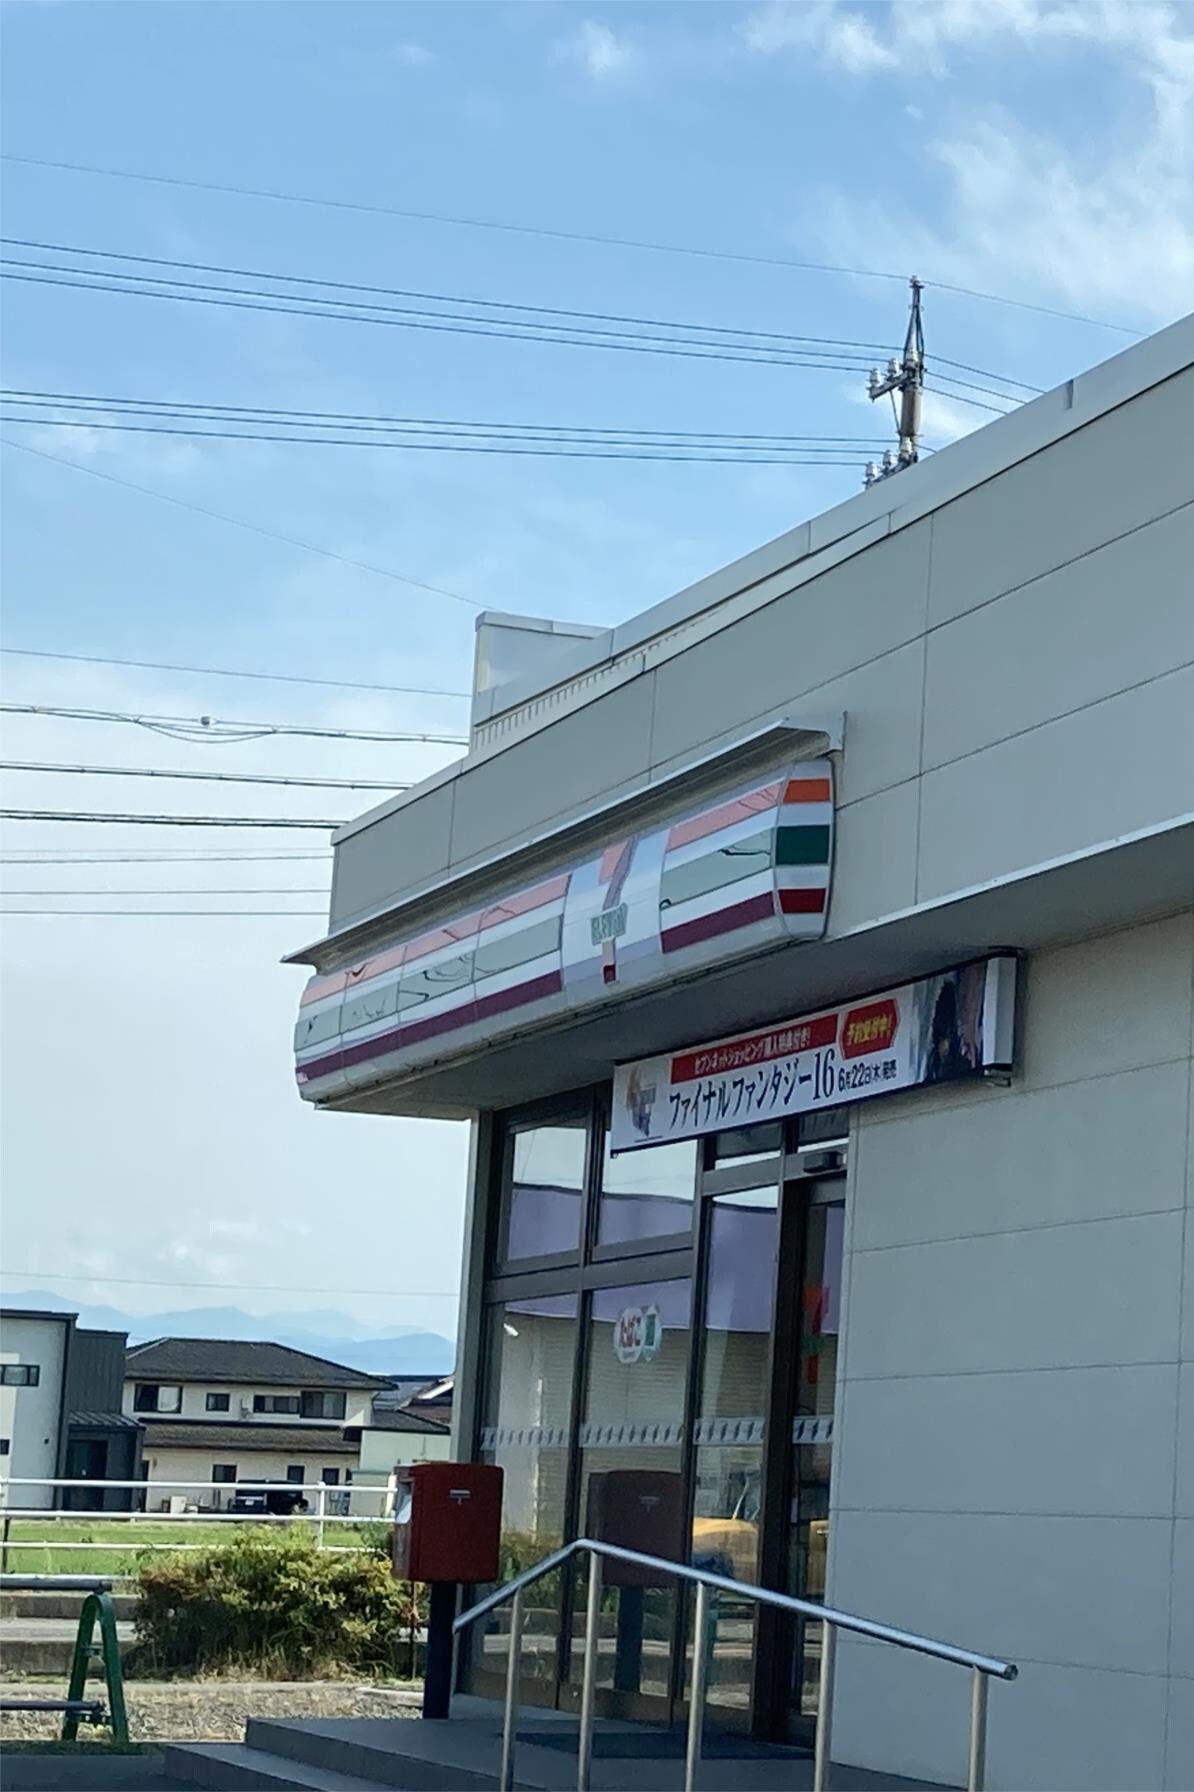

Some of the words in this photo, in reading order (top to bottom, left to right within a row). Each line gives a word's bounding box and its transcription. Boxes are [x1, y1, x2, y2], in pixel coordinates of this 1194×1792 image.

[669, 1048, 835, 1129] ファイナルファンタジー16
